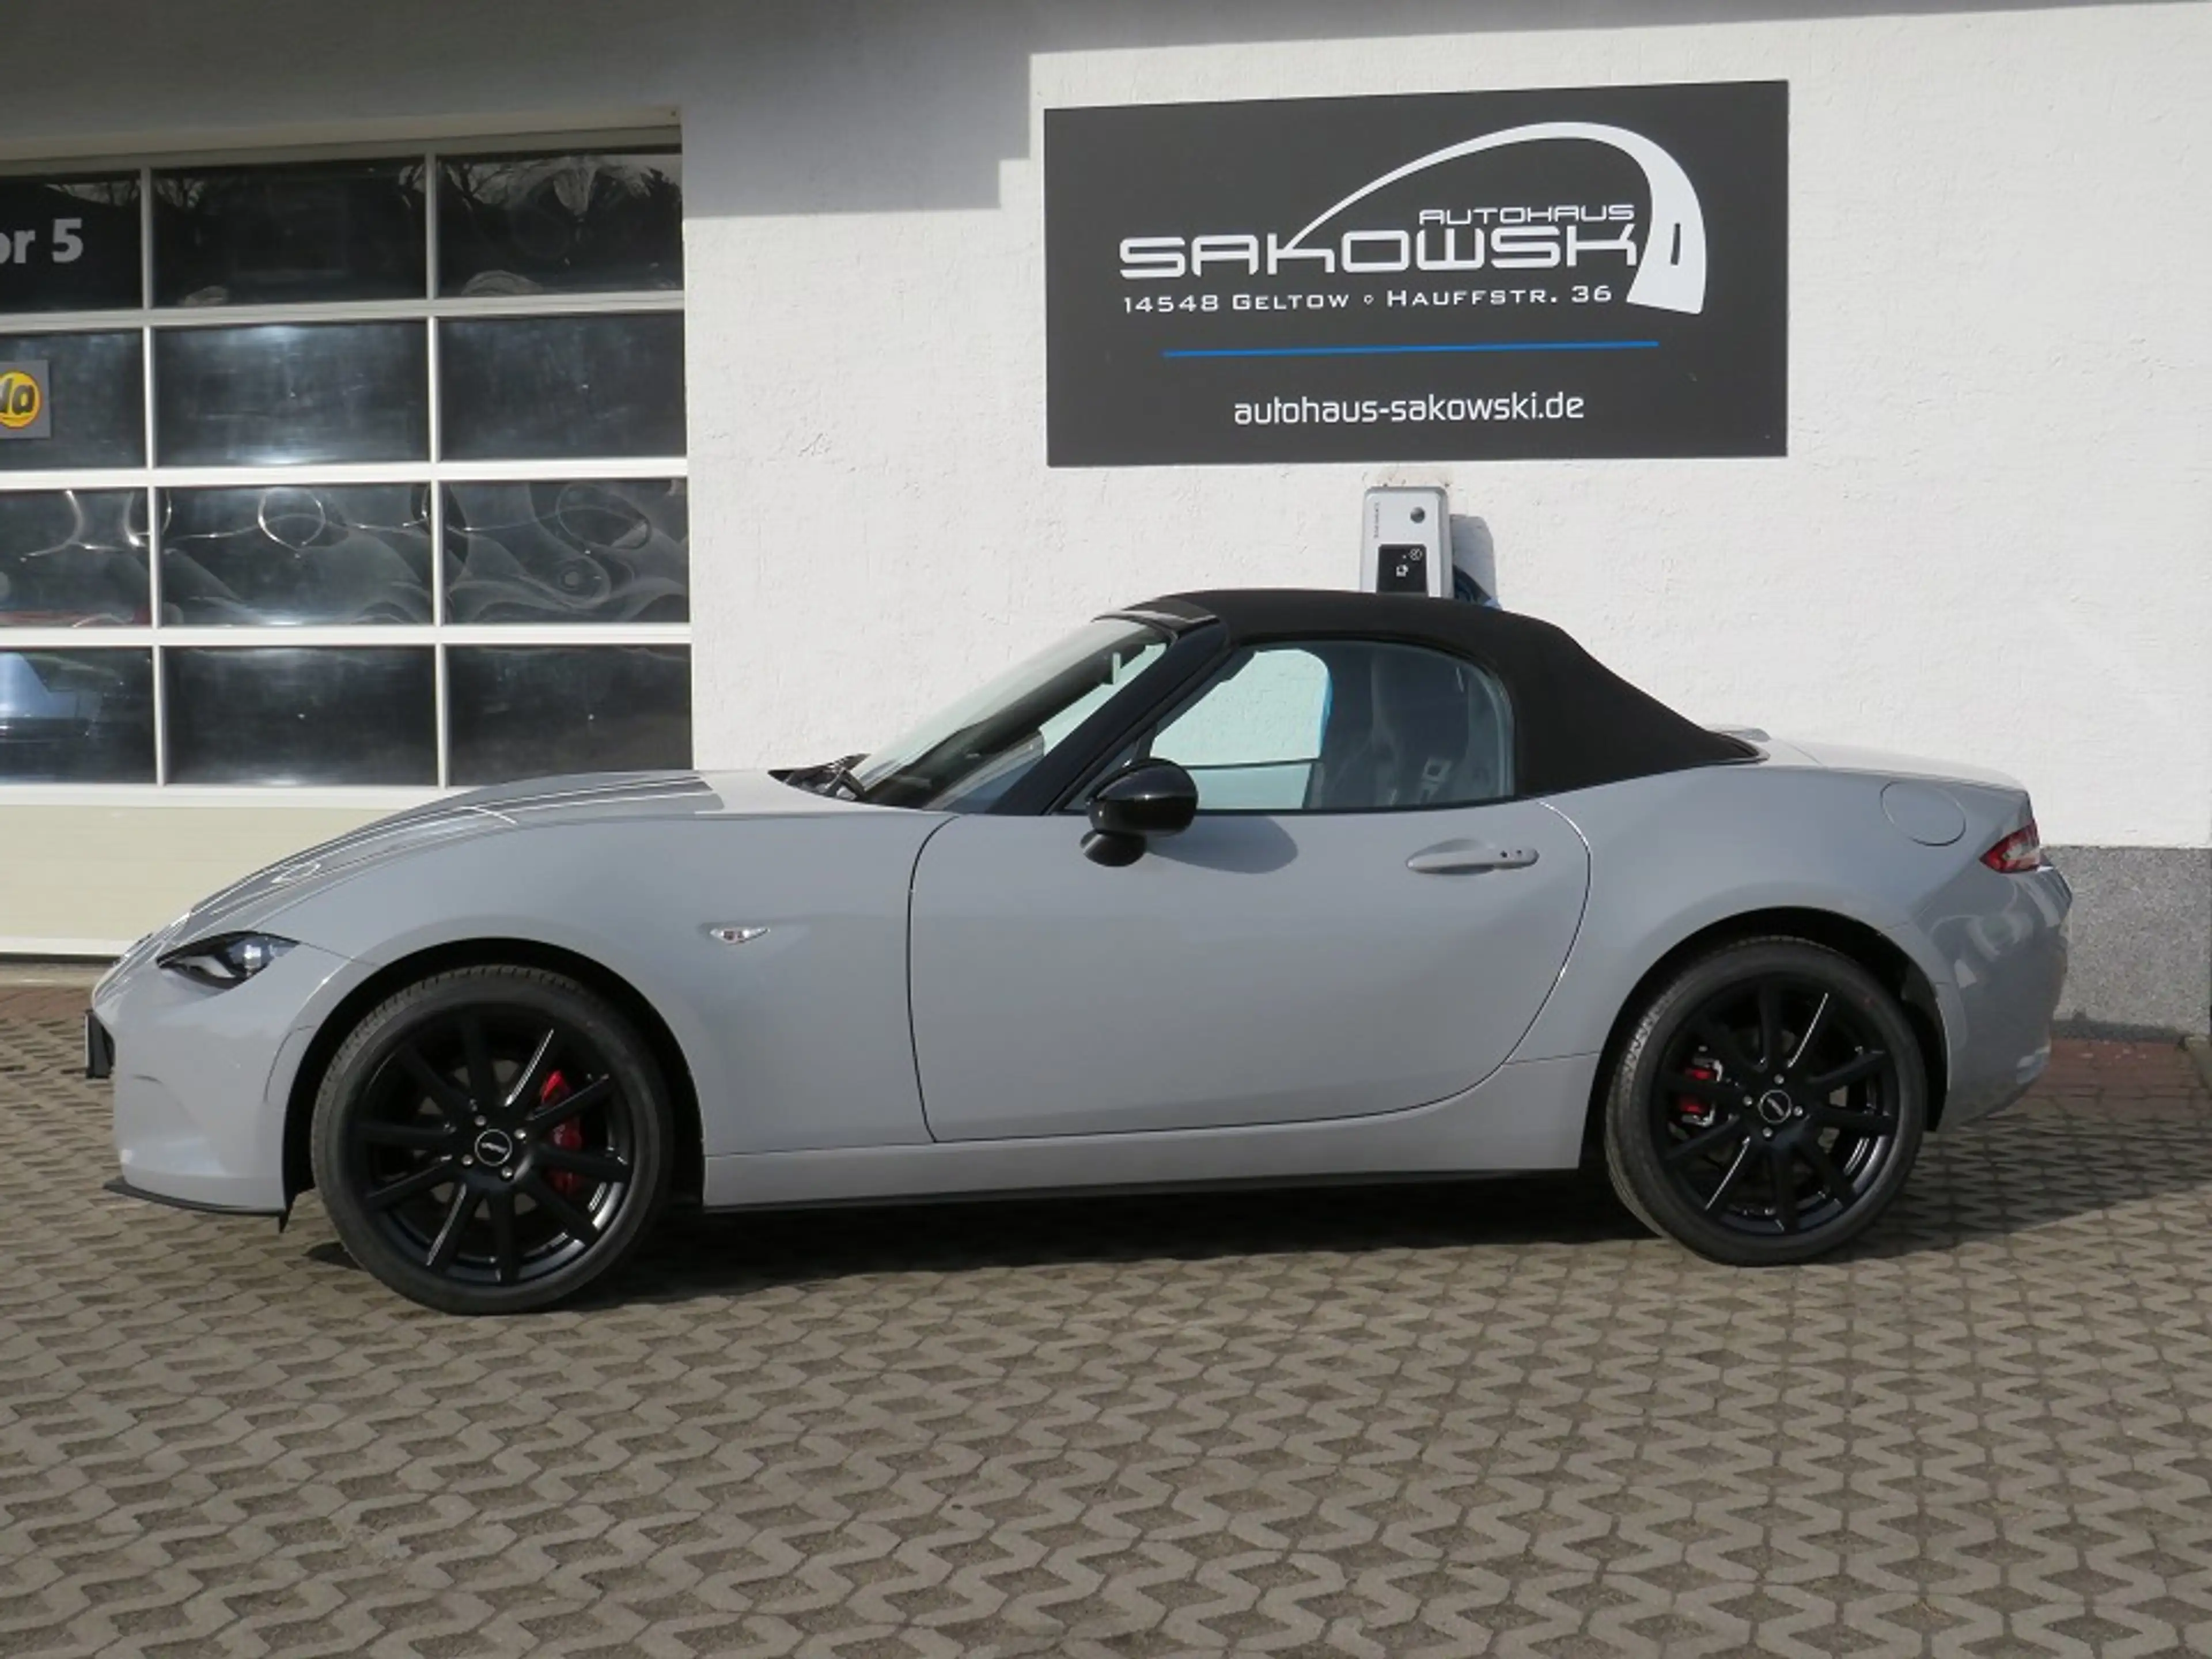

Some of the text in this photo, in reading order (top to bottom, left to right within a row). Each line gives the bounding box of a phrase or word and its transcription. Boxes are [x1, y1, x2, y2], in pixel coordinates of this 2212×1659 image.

[1418, 203, 1635, 225] AUTOHAUS
[52, 218, 84, 263] 5
[1123, 294, 1220, 315] 14548
[1570, 285, 1613, 304] 36
[1234, 390, 1585, 426] autohaus-sakowski.de
